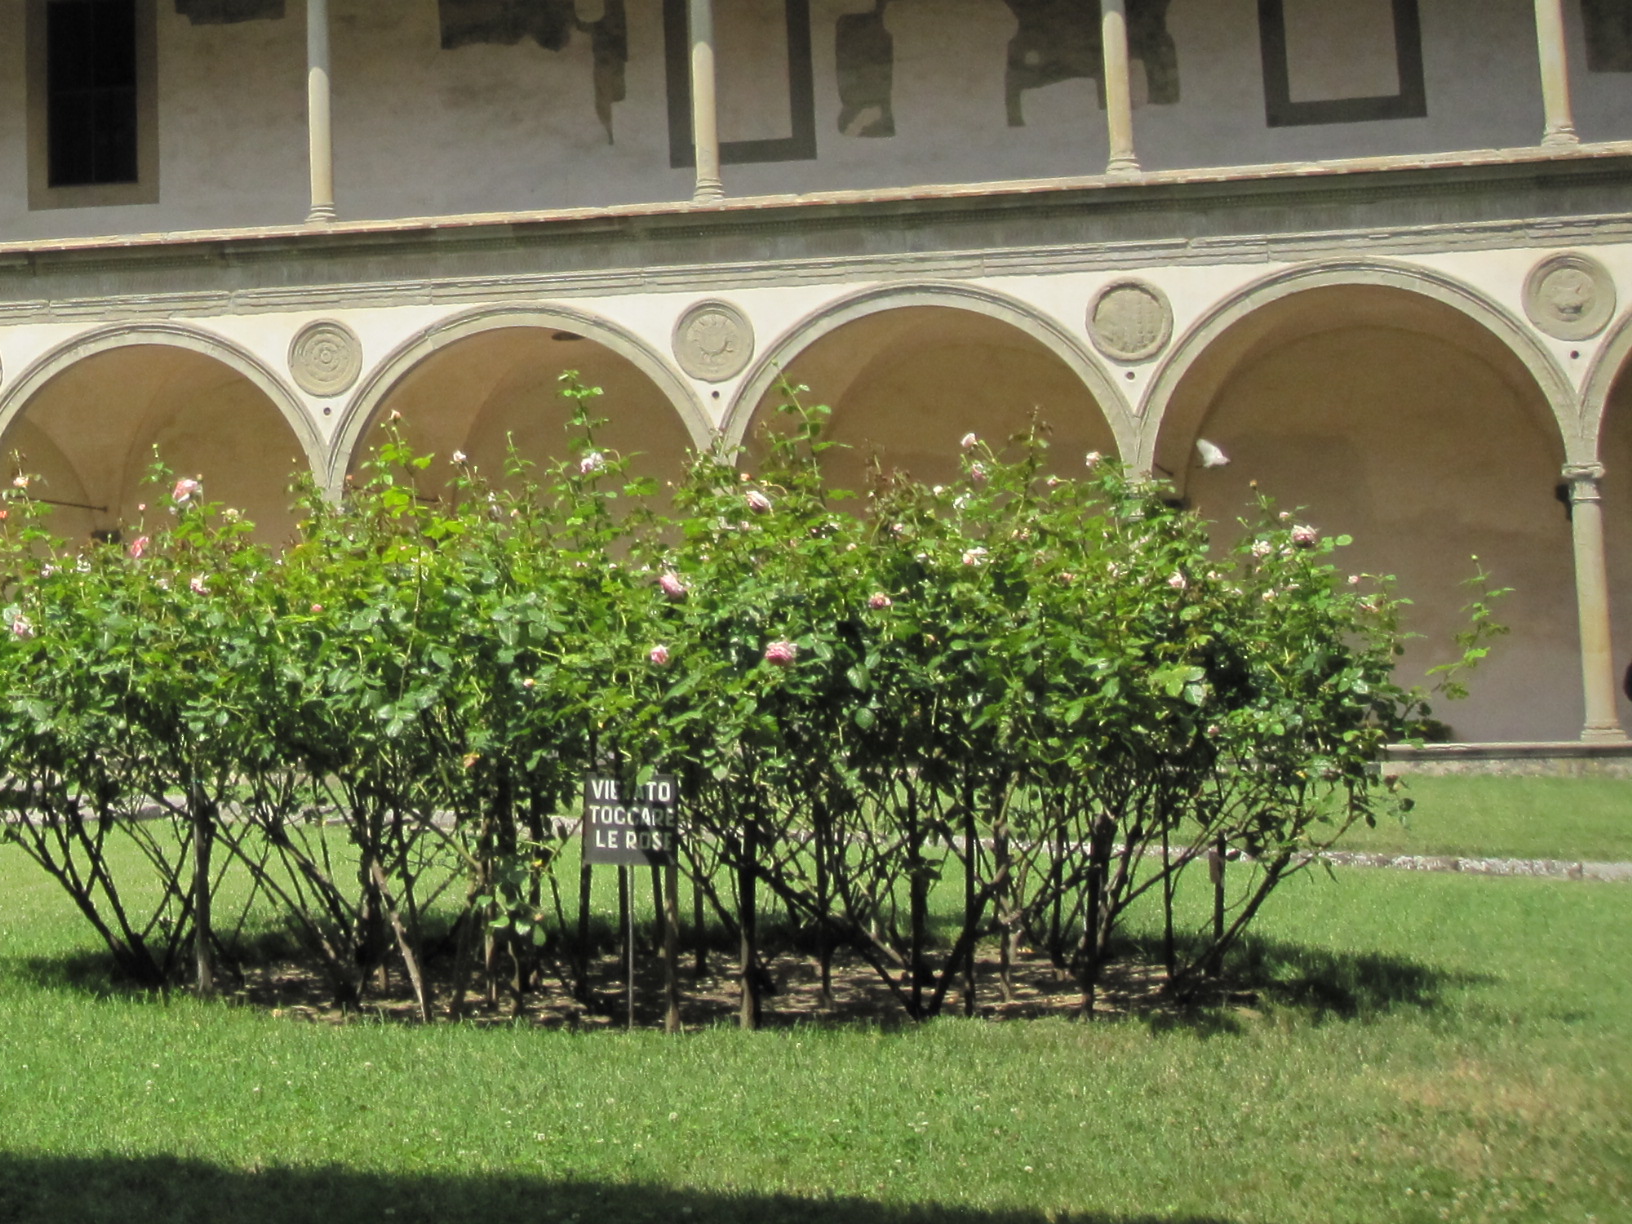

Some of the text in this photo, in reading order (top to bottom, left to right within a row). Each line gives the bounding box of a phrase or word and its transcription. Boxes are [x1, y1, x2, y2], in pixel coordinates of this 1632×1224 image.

[591, 779, 671, 802] VIEATO
[589, 805, 675, 827] TOCCARE
[595, 830, 673, 851] LE ROSE
